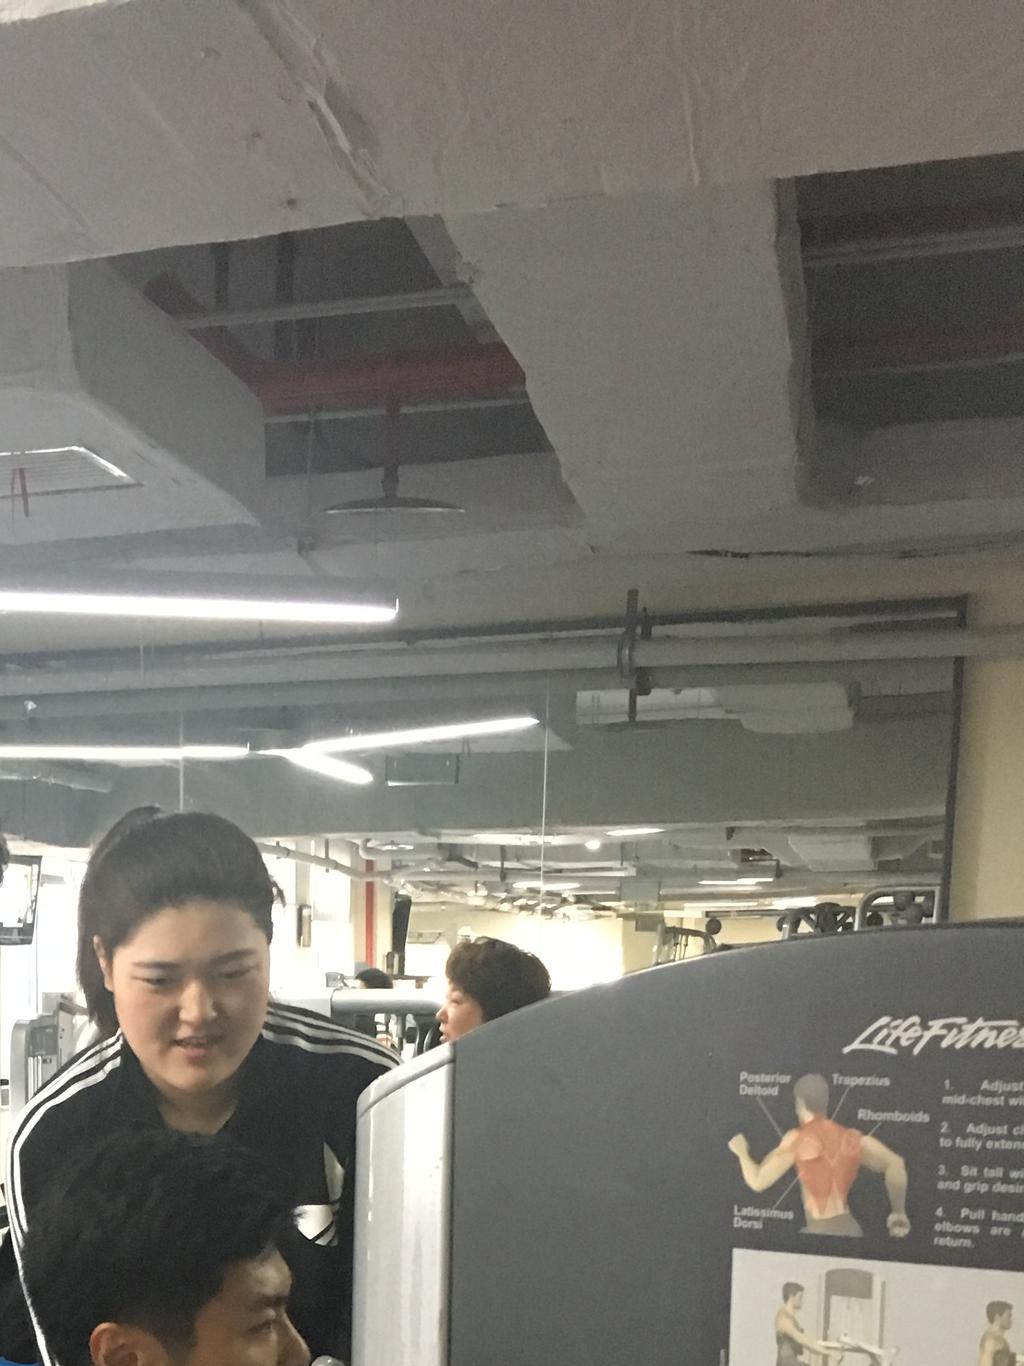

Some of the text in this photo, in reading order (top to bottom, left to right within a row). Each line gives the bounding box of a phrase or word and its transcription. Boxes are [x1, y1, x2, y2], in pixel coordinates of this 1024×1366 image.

[739, 1071, 792, 1084] Posterior
[831, 1073, 891, 1088] Trapezius
[739, 1084, 779, 1097] Deltoid
[857, 1109, 930, 1123] Rhomboids
[966, 1122, 1008, 1136] Adjust
[939, 1137, 952, 1147] to
[955, 1137, 982, 1150] fully
[983, 1167, 1003, 1178] tall
[937, 1180, 960, 1191] and
[963, 1181, 989, 1193] grip
[733, 1205, 794, 1220] Latissimus
[960, 1207, 985, 1220] Pull
[733, 1217, 763, 1230] Dorsi
[934, 1221, 980, 1234] elbows
[990, 1226, 1011, 1236] are
